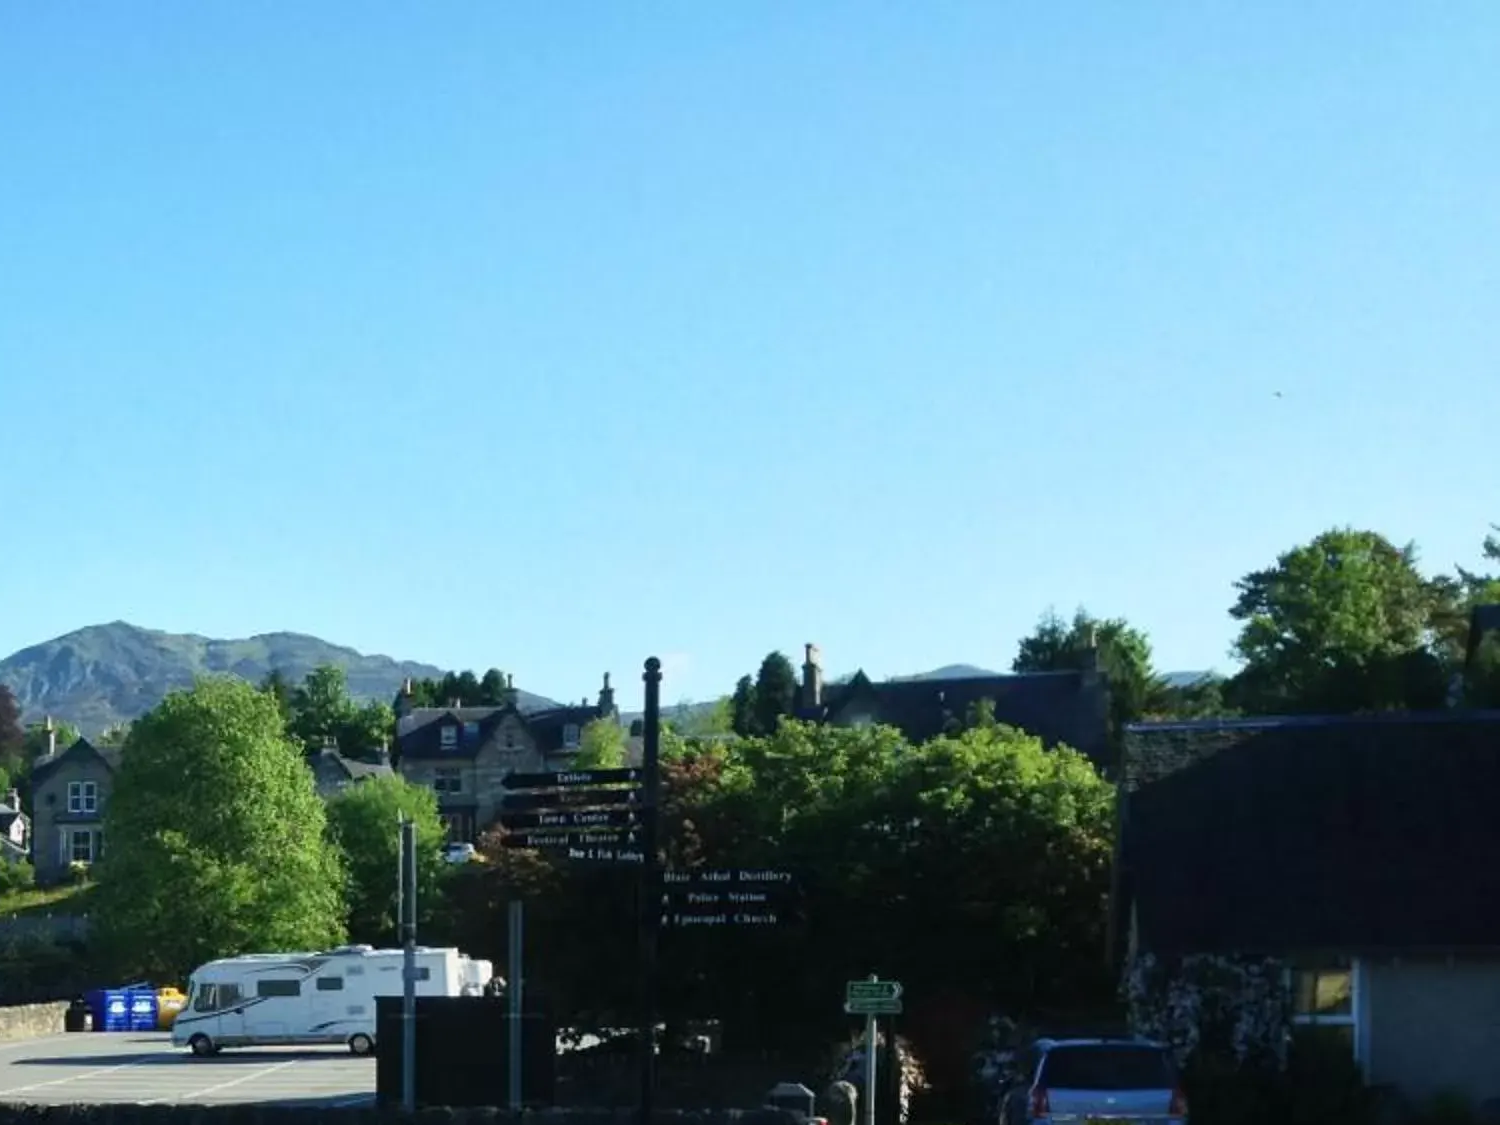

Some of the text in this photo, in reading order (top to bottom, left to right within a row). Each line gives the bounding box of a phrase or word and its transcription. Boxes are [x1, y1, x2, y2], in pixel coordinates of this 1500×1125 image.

[527, 833, 620, 845] Festival Theatre
[663, 870, 691, 883] Blair
[739, 869, 792, 884] Distillery
[687, 892, 767, 904] Police Station
[733, 913, 777, 924] Church
